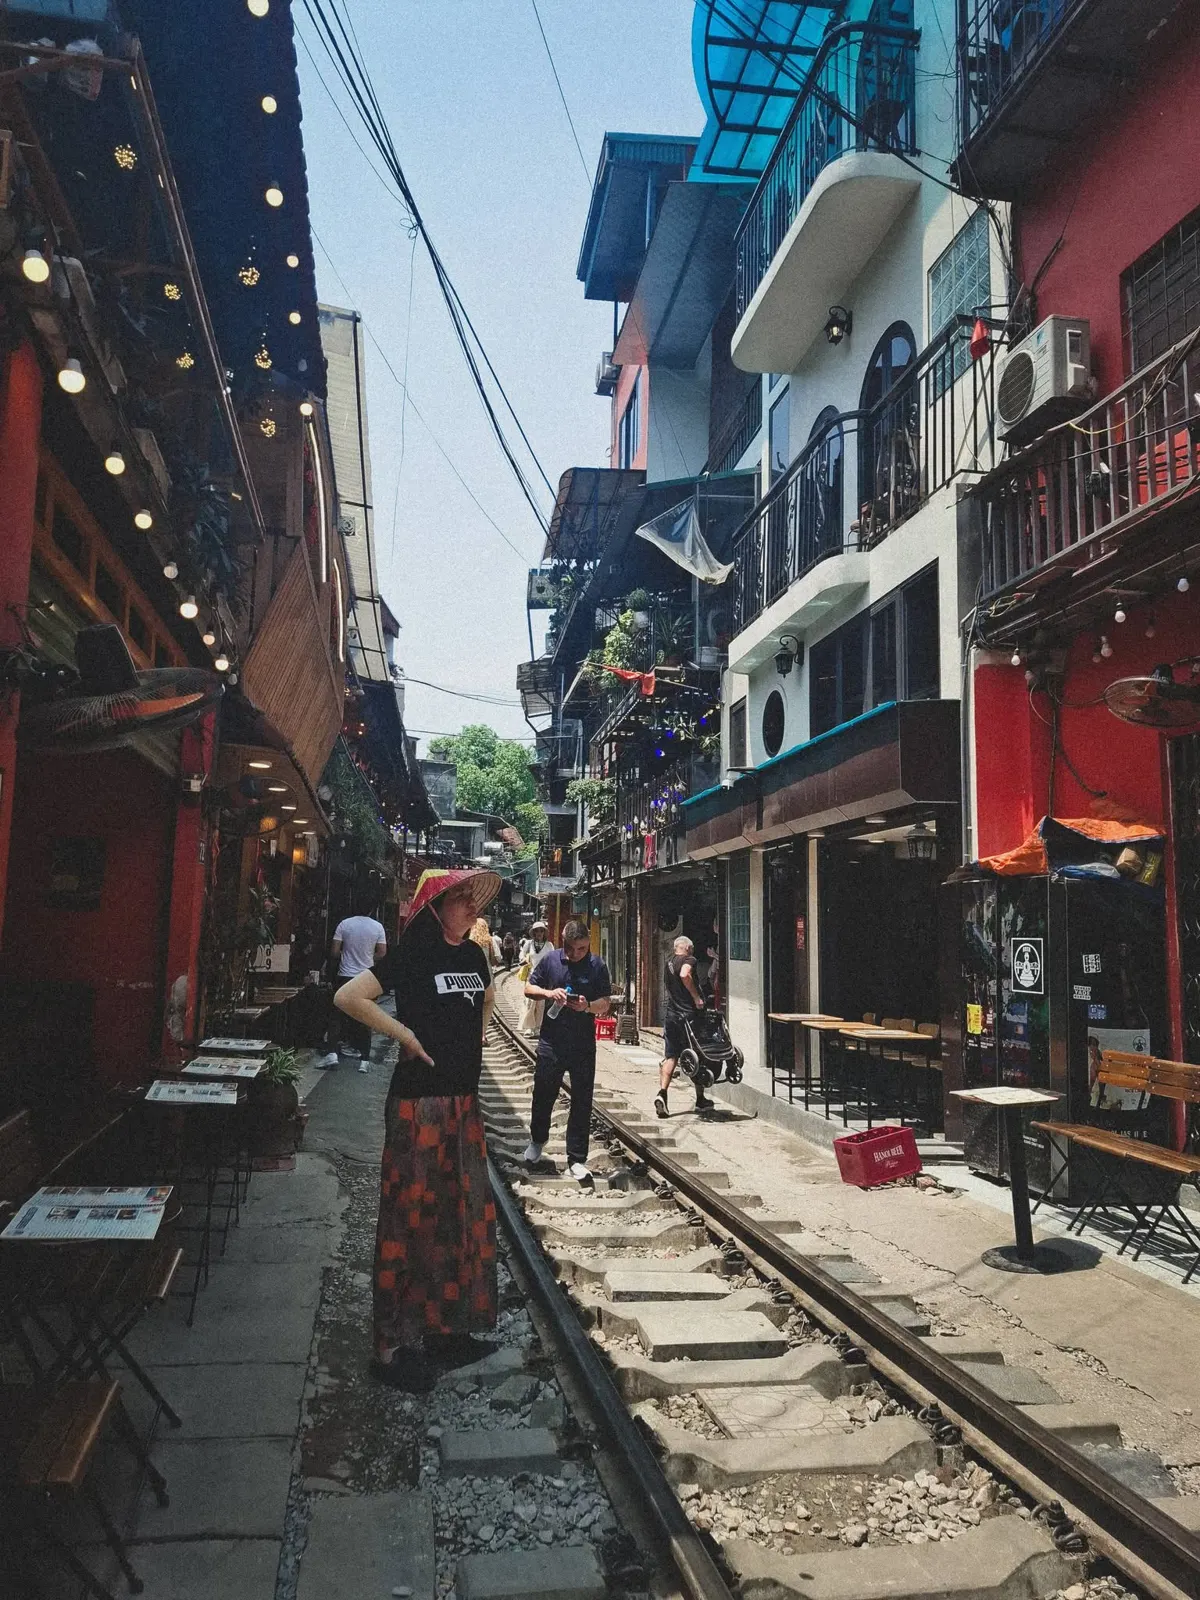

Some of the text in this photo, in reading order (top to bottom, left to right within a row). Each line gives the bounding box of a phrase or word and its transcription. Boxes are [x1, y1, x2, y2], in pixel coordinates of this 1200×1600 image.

[443, 975, 483, 990] PUMA
[873, 1144, 905, 1162] HANOI BEER
